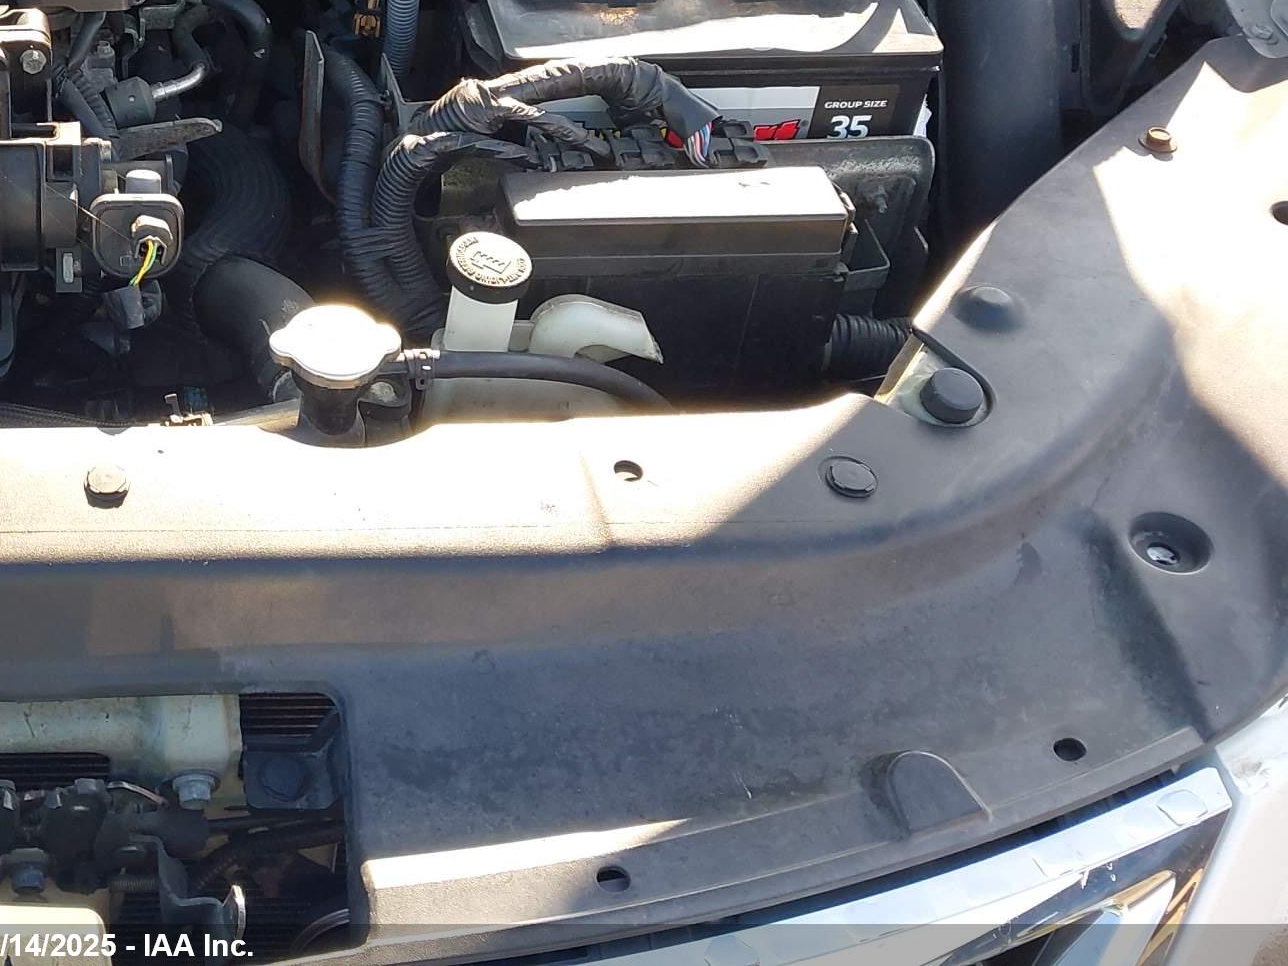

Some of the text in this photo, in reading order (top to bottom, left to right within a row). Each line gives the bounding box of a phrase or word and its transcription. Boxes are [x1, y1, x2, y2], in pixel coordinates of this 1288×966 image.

[824, 99, 888, 109] GROUP SIZE
[827, 114, 873, 139] 35
